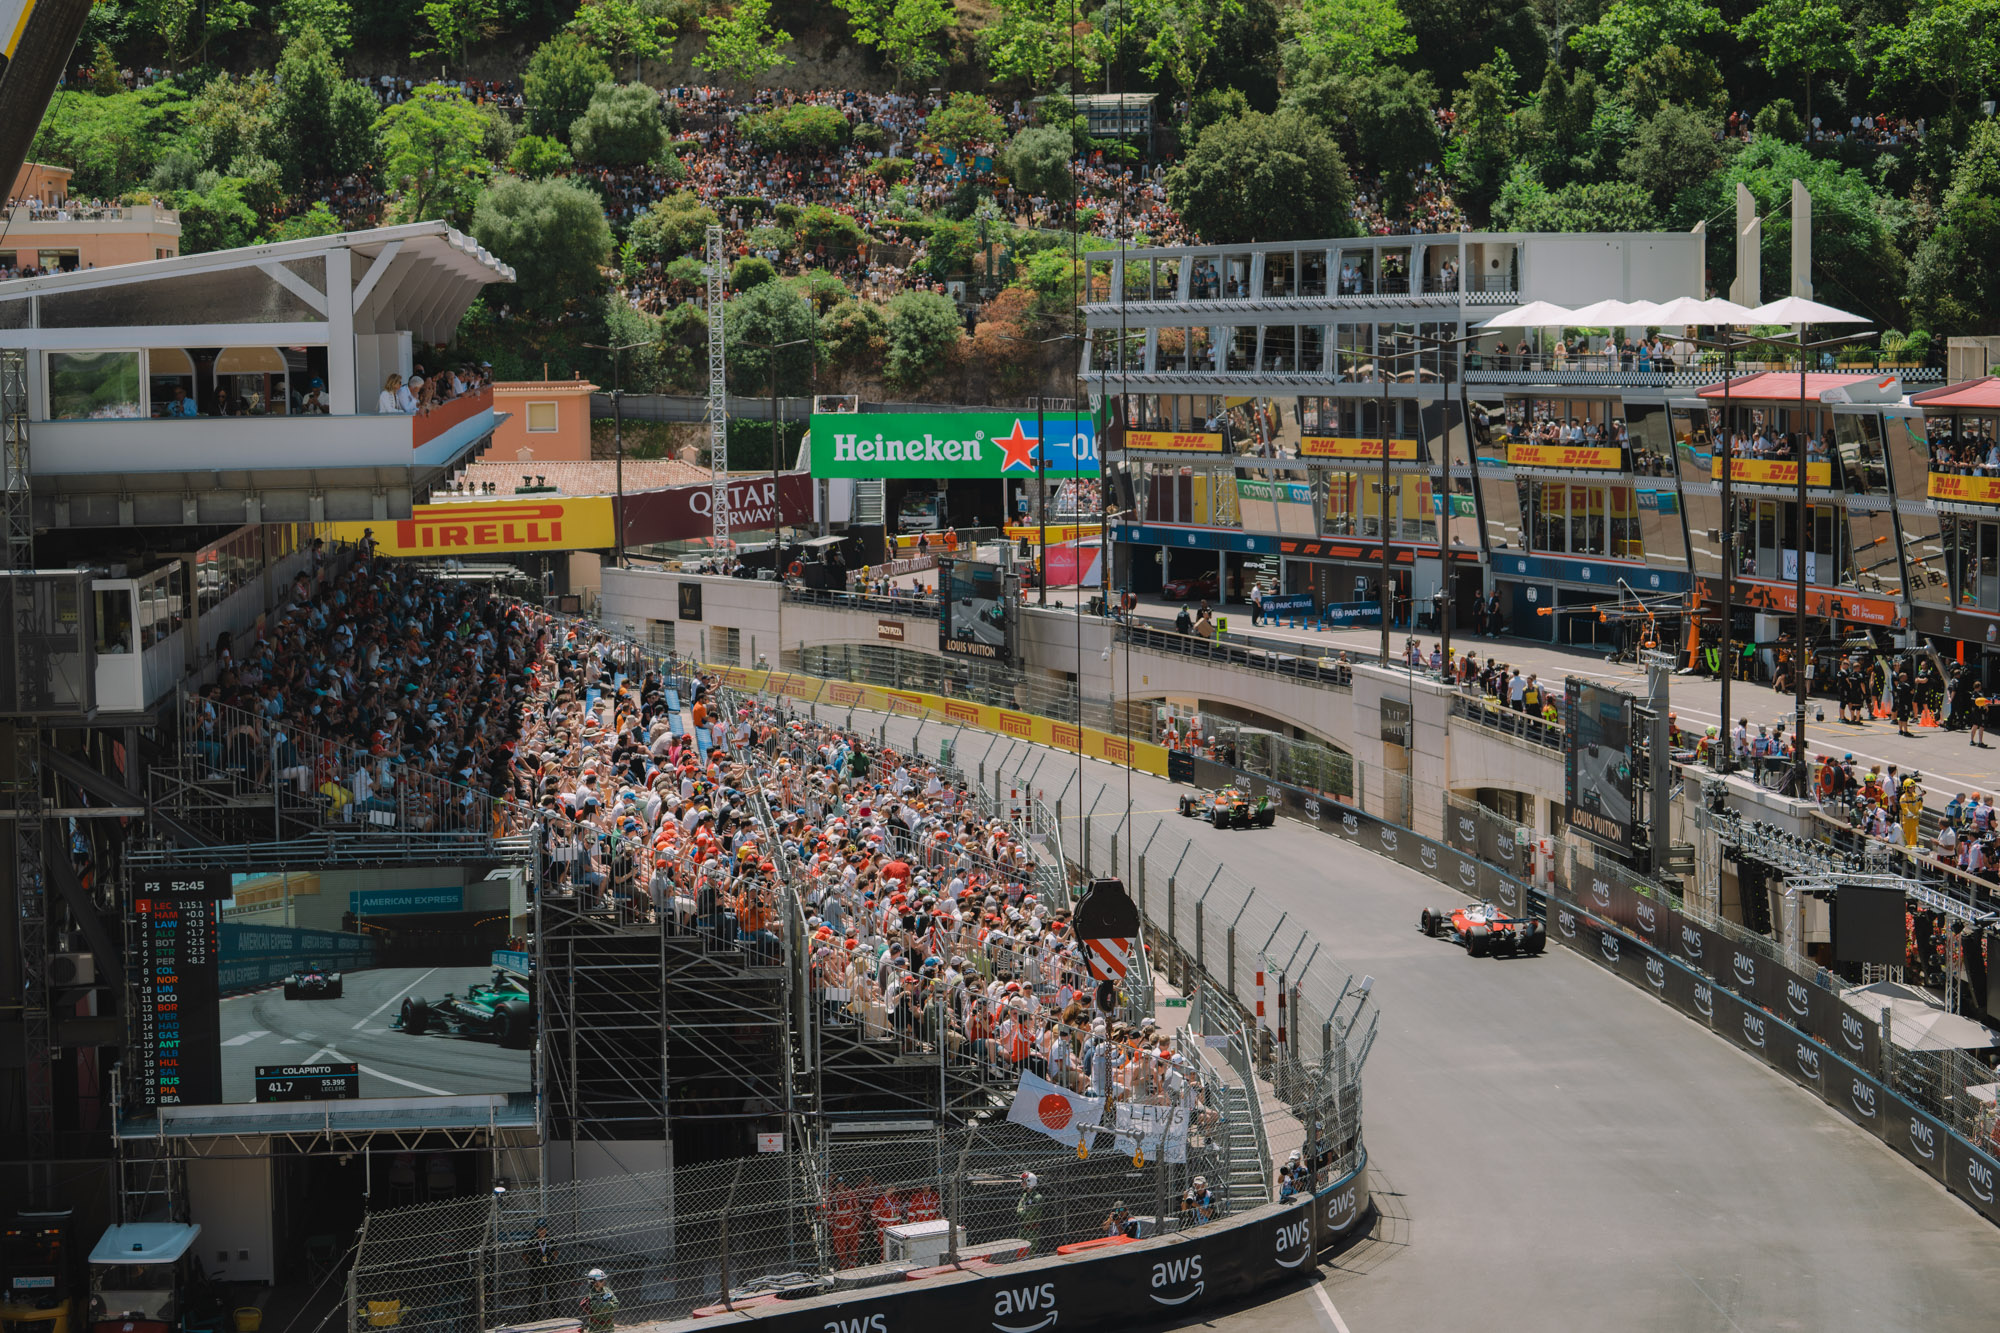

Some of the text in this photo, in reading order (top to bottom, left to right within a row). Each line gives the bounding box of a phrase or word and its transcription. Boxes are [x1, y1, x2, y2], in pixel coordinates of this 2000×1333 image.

[833, 434, 983, 461] Heineken
[1131, 434, 1152, 446] DHL
[1173, 436, 1206, 448] DHL
[1310, 440, 1336, 453] DHL
[1516, 447, 1540, 462] DHL
[1564, 450, 1600, 464] DHL
[1936, 477, 1962, 496] DHL
[397, 504, 564, 548] PIRELLI
[1276, 601, 1292, 609] PARC
[1293, 598, 1312, 608] FERMÉ
[1362, 606, 1381, 616] FERMÉ
[947, 640, 996, 657] LOUIS VUITTON
[1000, 714, 1031, 737] PIRELLI
[1104, 738, 1135, 764] PIRELLI
[1236, 774, 1250, 788] aws
[1266, 785, 1281, 798] aws
[1305, 798, 1319, 812] aws
[1343, 812, 1358, 827] aws
[1459, 816, 1474, 832] aws
[1573, 808, 1592, 830] LOUIS
[1594, 816, 1622, 842] VUITTON
[1381, 827, 1397, 842] aws
[1498, 834, 1513, 851] aws
[1421, 844, 1436, 860] aws
[1460, 861, 1475, 878] aws
[145, 881, 205, 891] P3 52:45
[1500, 880, 1515, 897] aws
[1592, 878, 1609, 898] aws
[363, 896, 458, 906] AMERICAN EXPRESS
[1559, 910, 1574, 929] aws
[1637, 901, 1654, 922] aws
[238, 933, 292, 950] AMERICAN EXPRESS
[1602, 932, 1618, 952] aws
[1682, 926, 1701, 947] aws
[1646, 956, 1664, 978] aws
[1734, 952, 1754, 974] aws
[1694, 983, 1712, 1005] aws
[1788, 980, 1807, 1004] aws
[1744, 1012, 1764, 1036] aws
[1842, 1013, 1863, 1039] aws
[1797, 1044, 1818, 1068] aws
[283, 1066, 331, 1074] COLAPINTO
[268, 1082, 293, 1092] 41.7
[1853, 1078, 1875, 1105] aws
[1911, 1117, 1933, 1146] aws
[1969, 1158, 1992, 1189] aws
[1328, 1187, 1355, 1219] aws
[1276, 1218, 1309, 1252] aws
[1151, 1255, 1202, 1288] aws
[995, 1283, 1055, 1316] aws
